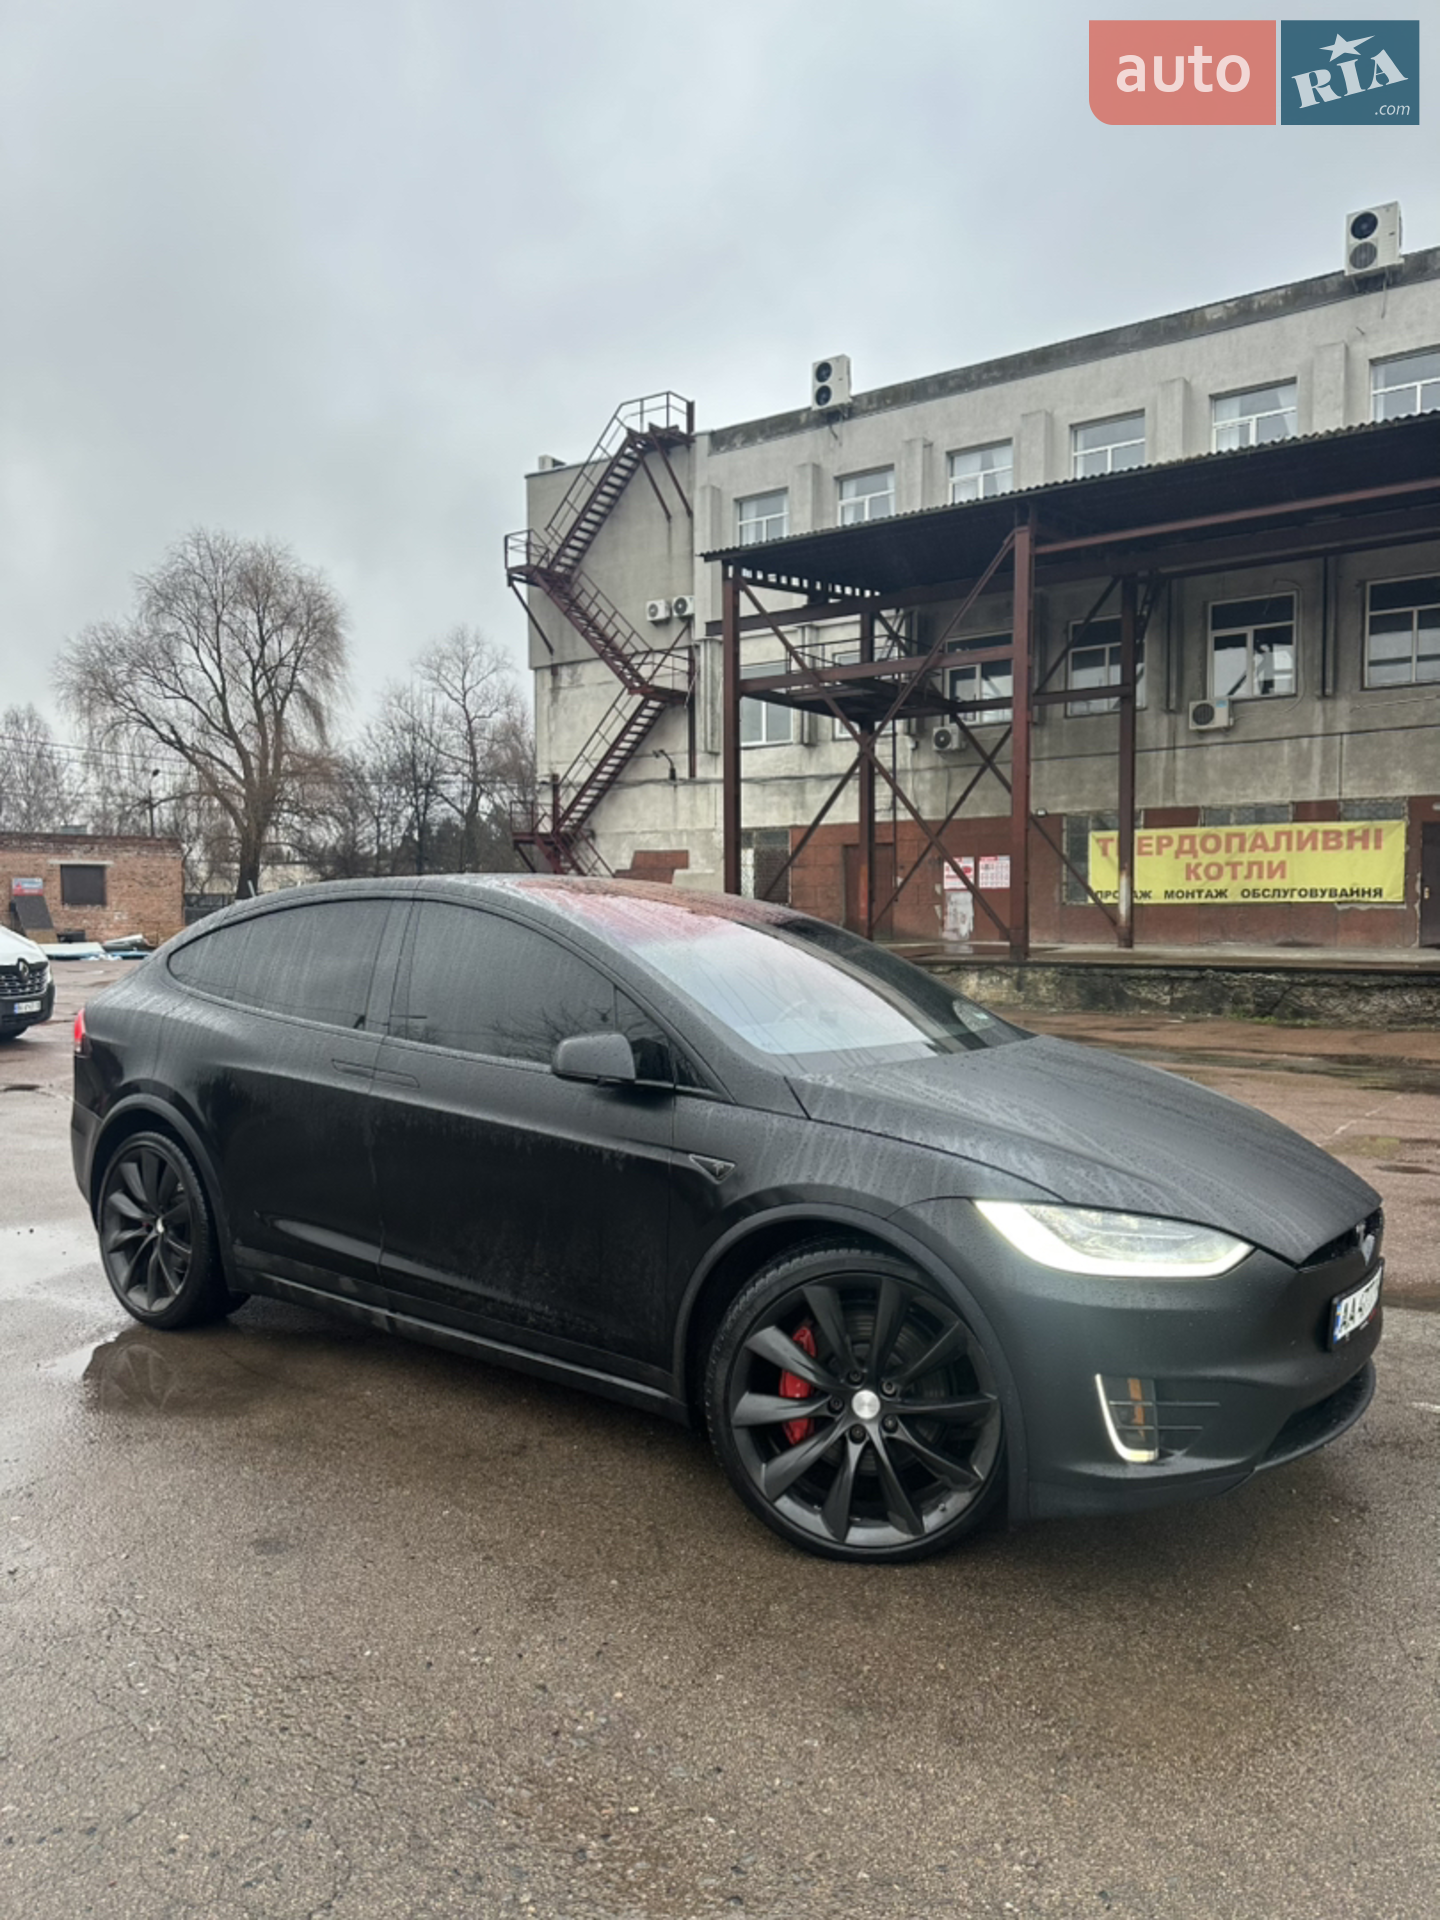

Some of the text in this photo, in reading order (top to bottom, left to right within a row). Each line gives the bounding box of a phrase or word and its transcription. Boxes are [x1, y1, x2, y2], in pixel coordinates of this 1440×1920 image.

[1096, 828, 1384, 859] ТЕРДОПАЛИВНІ
[1185, 860, 1287, 881] КОТЛИ
[1163, 889, 1229, 900] МОНТАЖ
[1240, 887, 1384, 899] ОБСЛУГОВУВАННЯ
